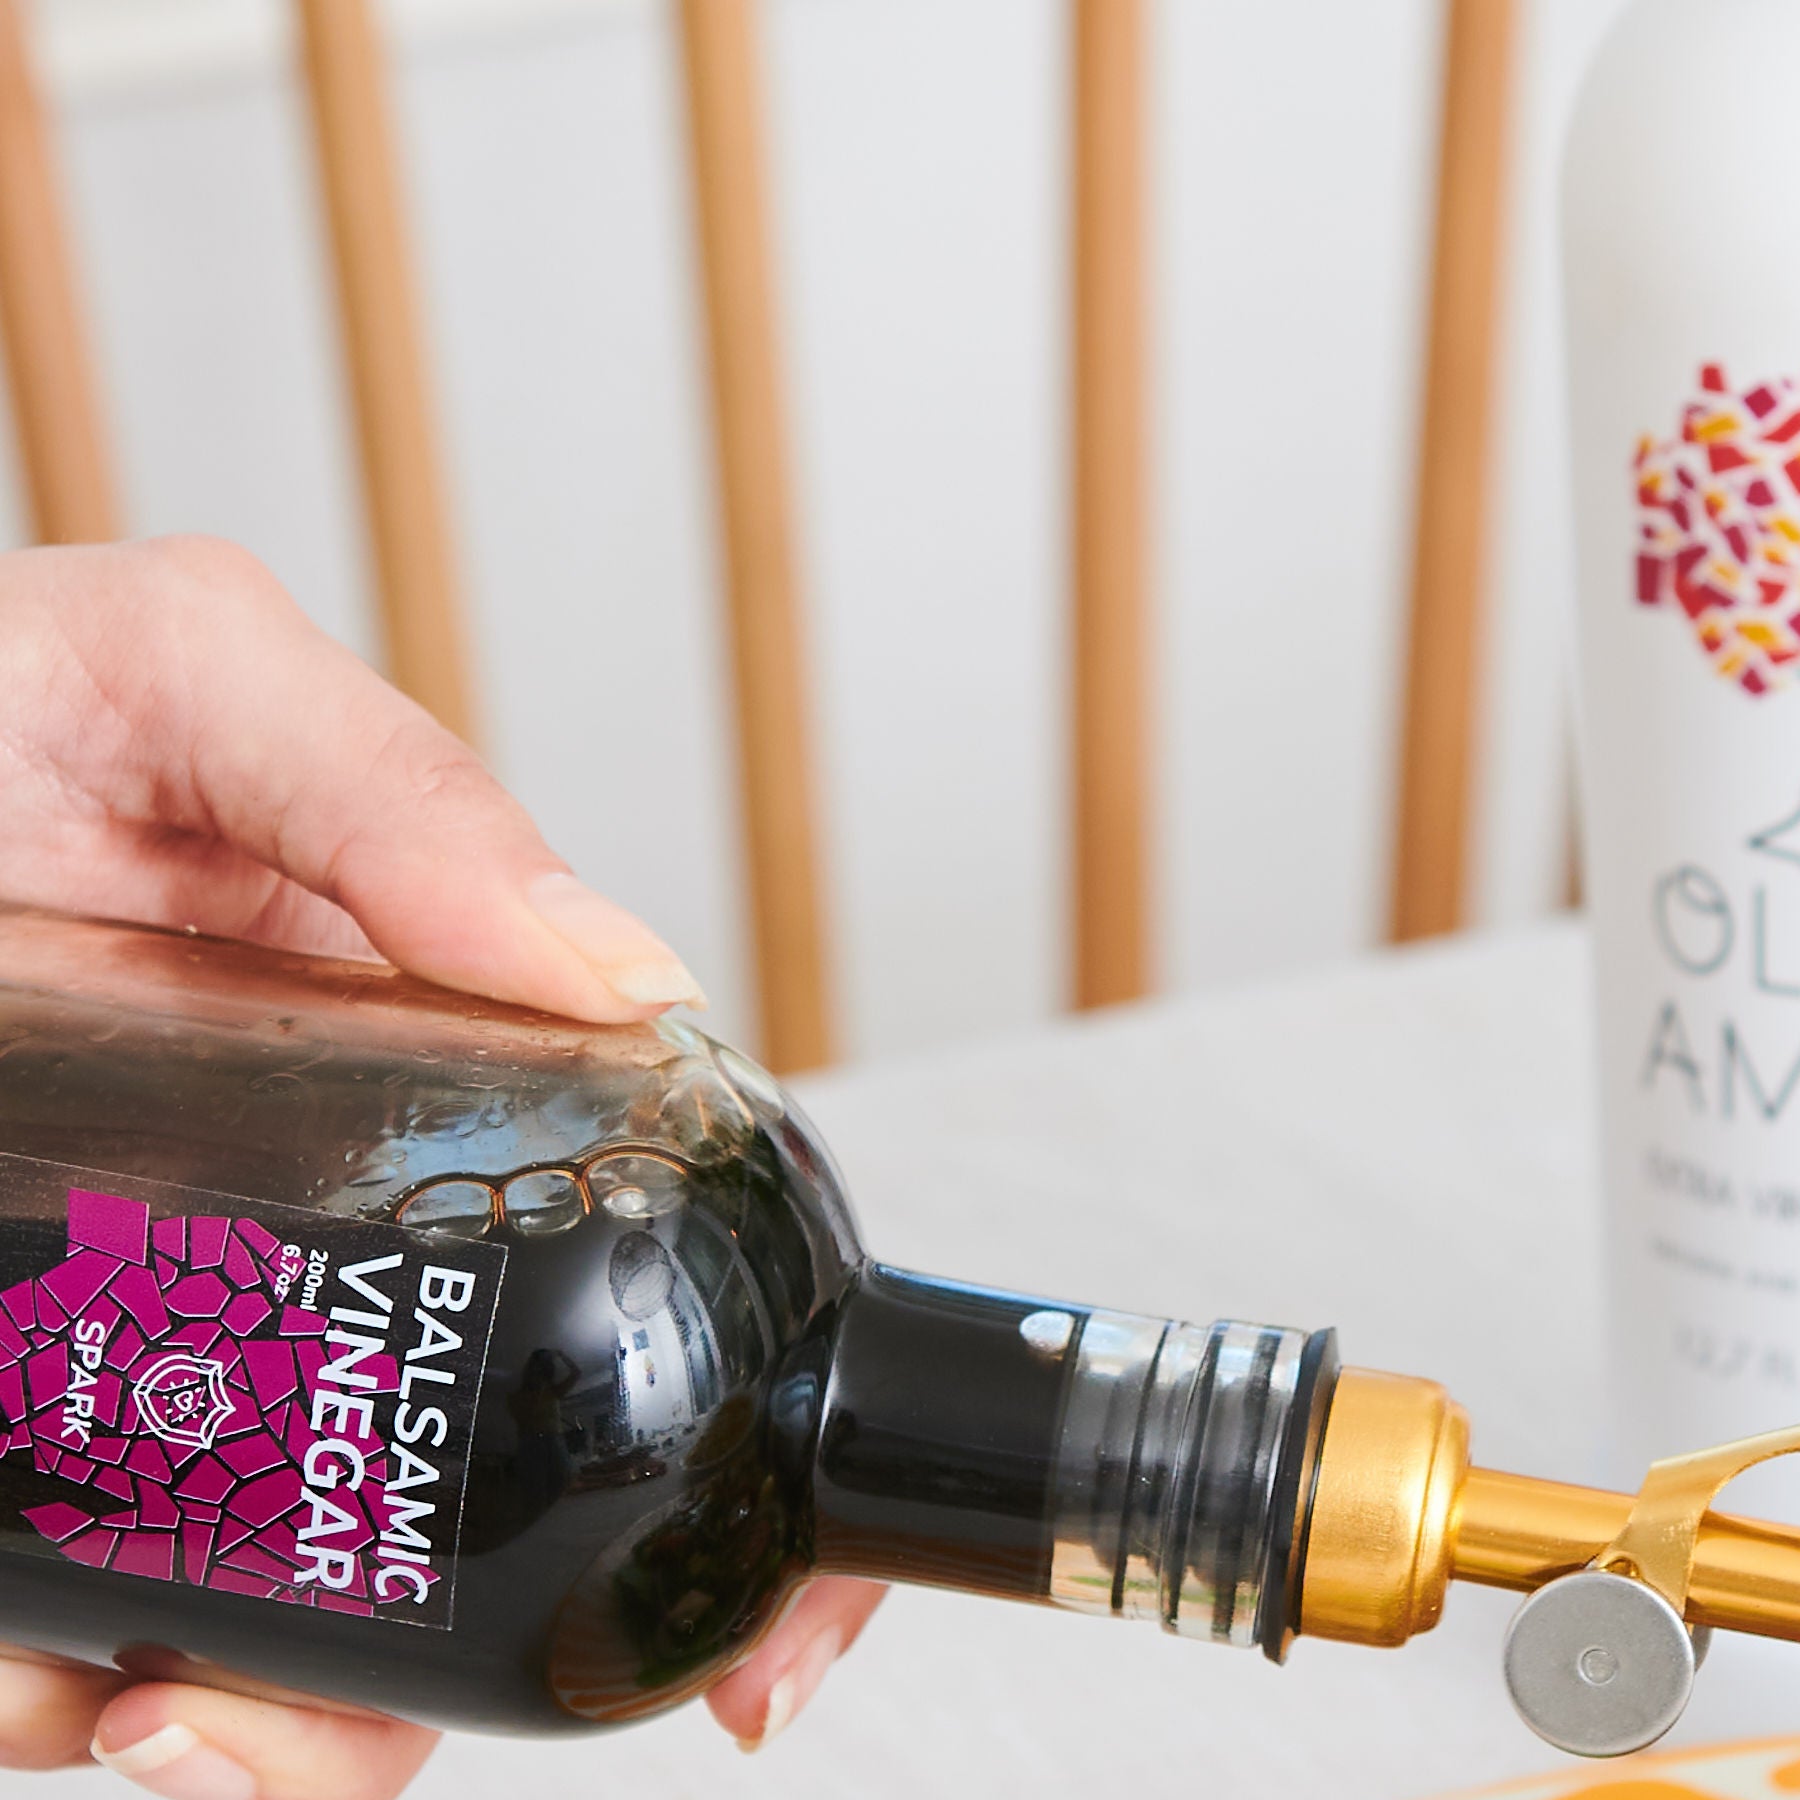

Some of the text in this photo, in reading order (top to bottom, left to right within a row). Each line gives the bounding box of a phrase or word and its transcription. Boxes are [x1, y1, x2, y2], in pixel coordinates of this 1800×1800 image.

[273, 1243, 302, 1303] 6.7oz
[300, 1248, 329, 1311] 200ml
[60, 1318, 106, 1444] SPARK
[293, 1252, 403, 1590] VINEGAR
[374, 1264, 477, 1605] BALSAMIC
